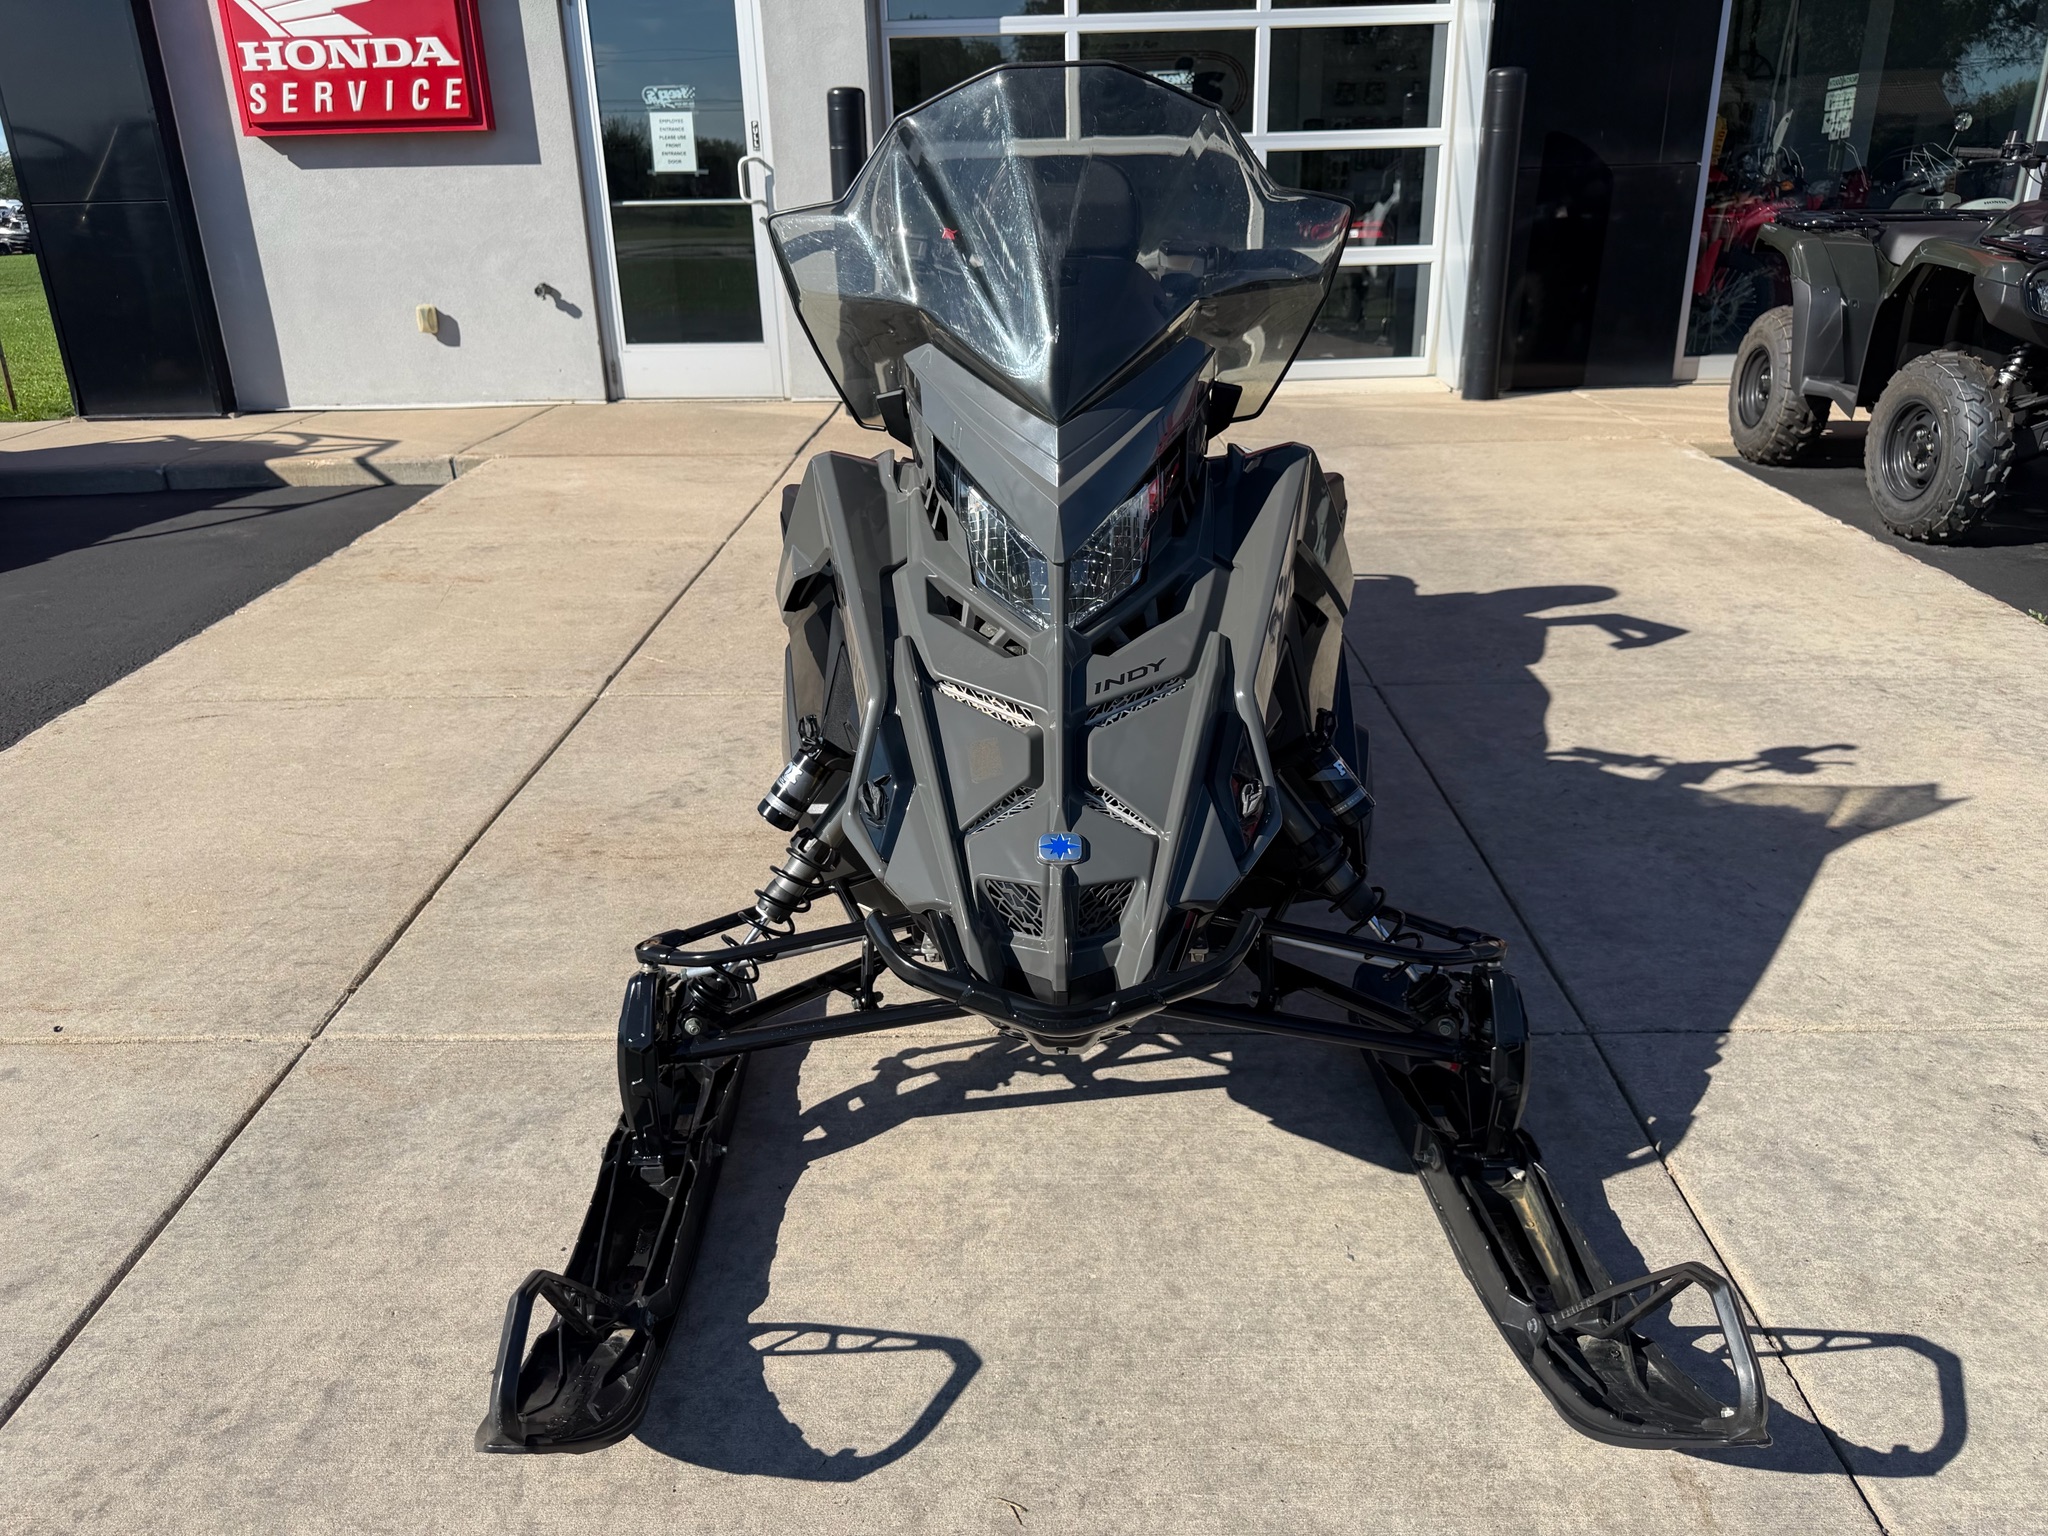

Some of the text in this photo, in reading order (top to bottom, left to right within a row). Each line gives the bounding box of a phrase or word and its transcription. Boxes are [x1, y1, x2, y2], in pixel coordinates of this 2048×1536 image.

[238, 37, 460, 72] HONDA
[250, 78, 463, 115] SERVICE
[1095, 657, 1167, 695] INDY
